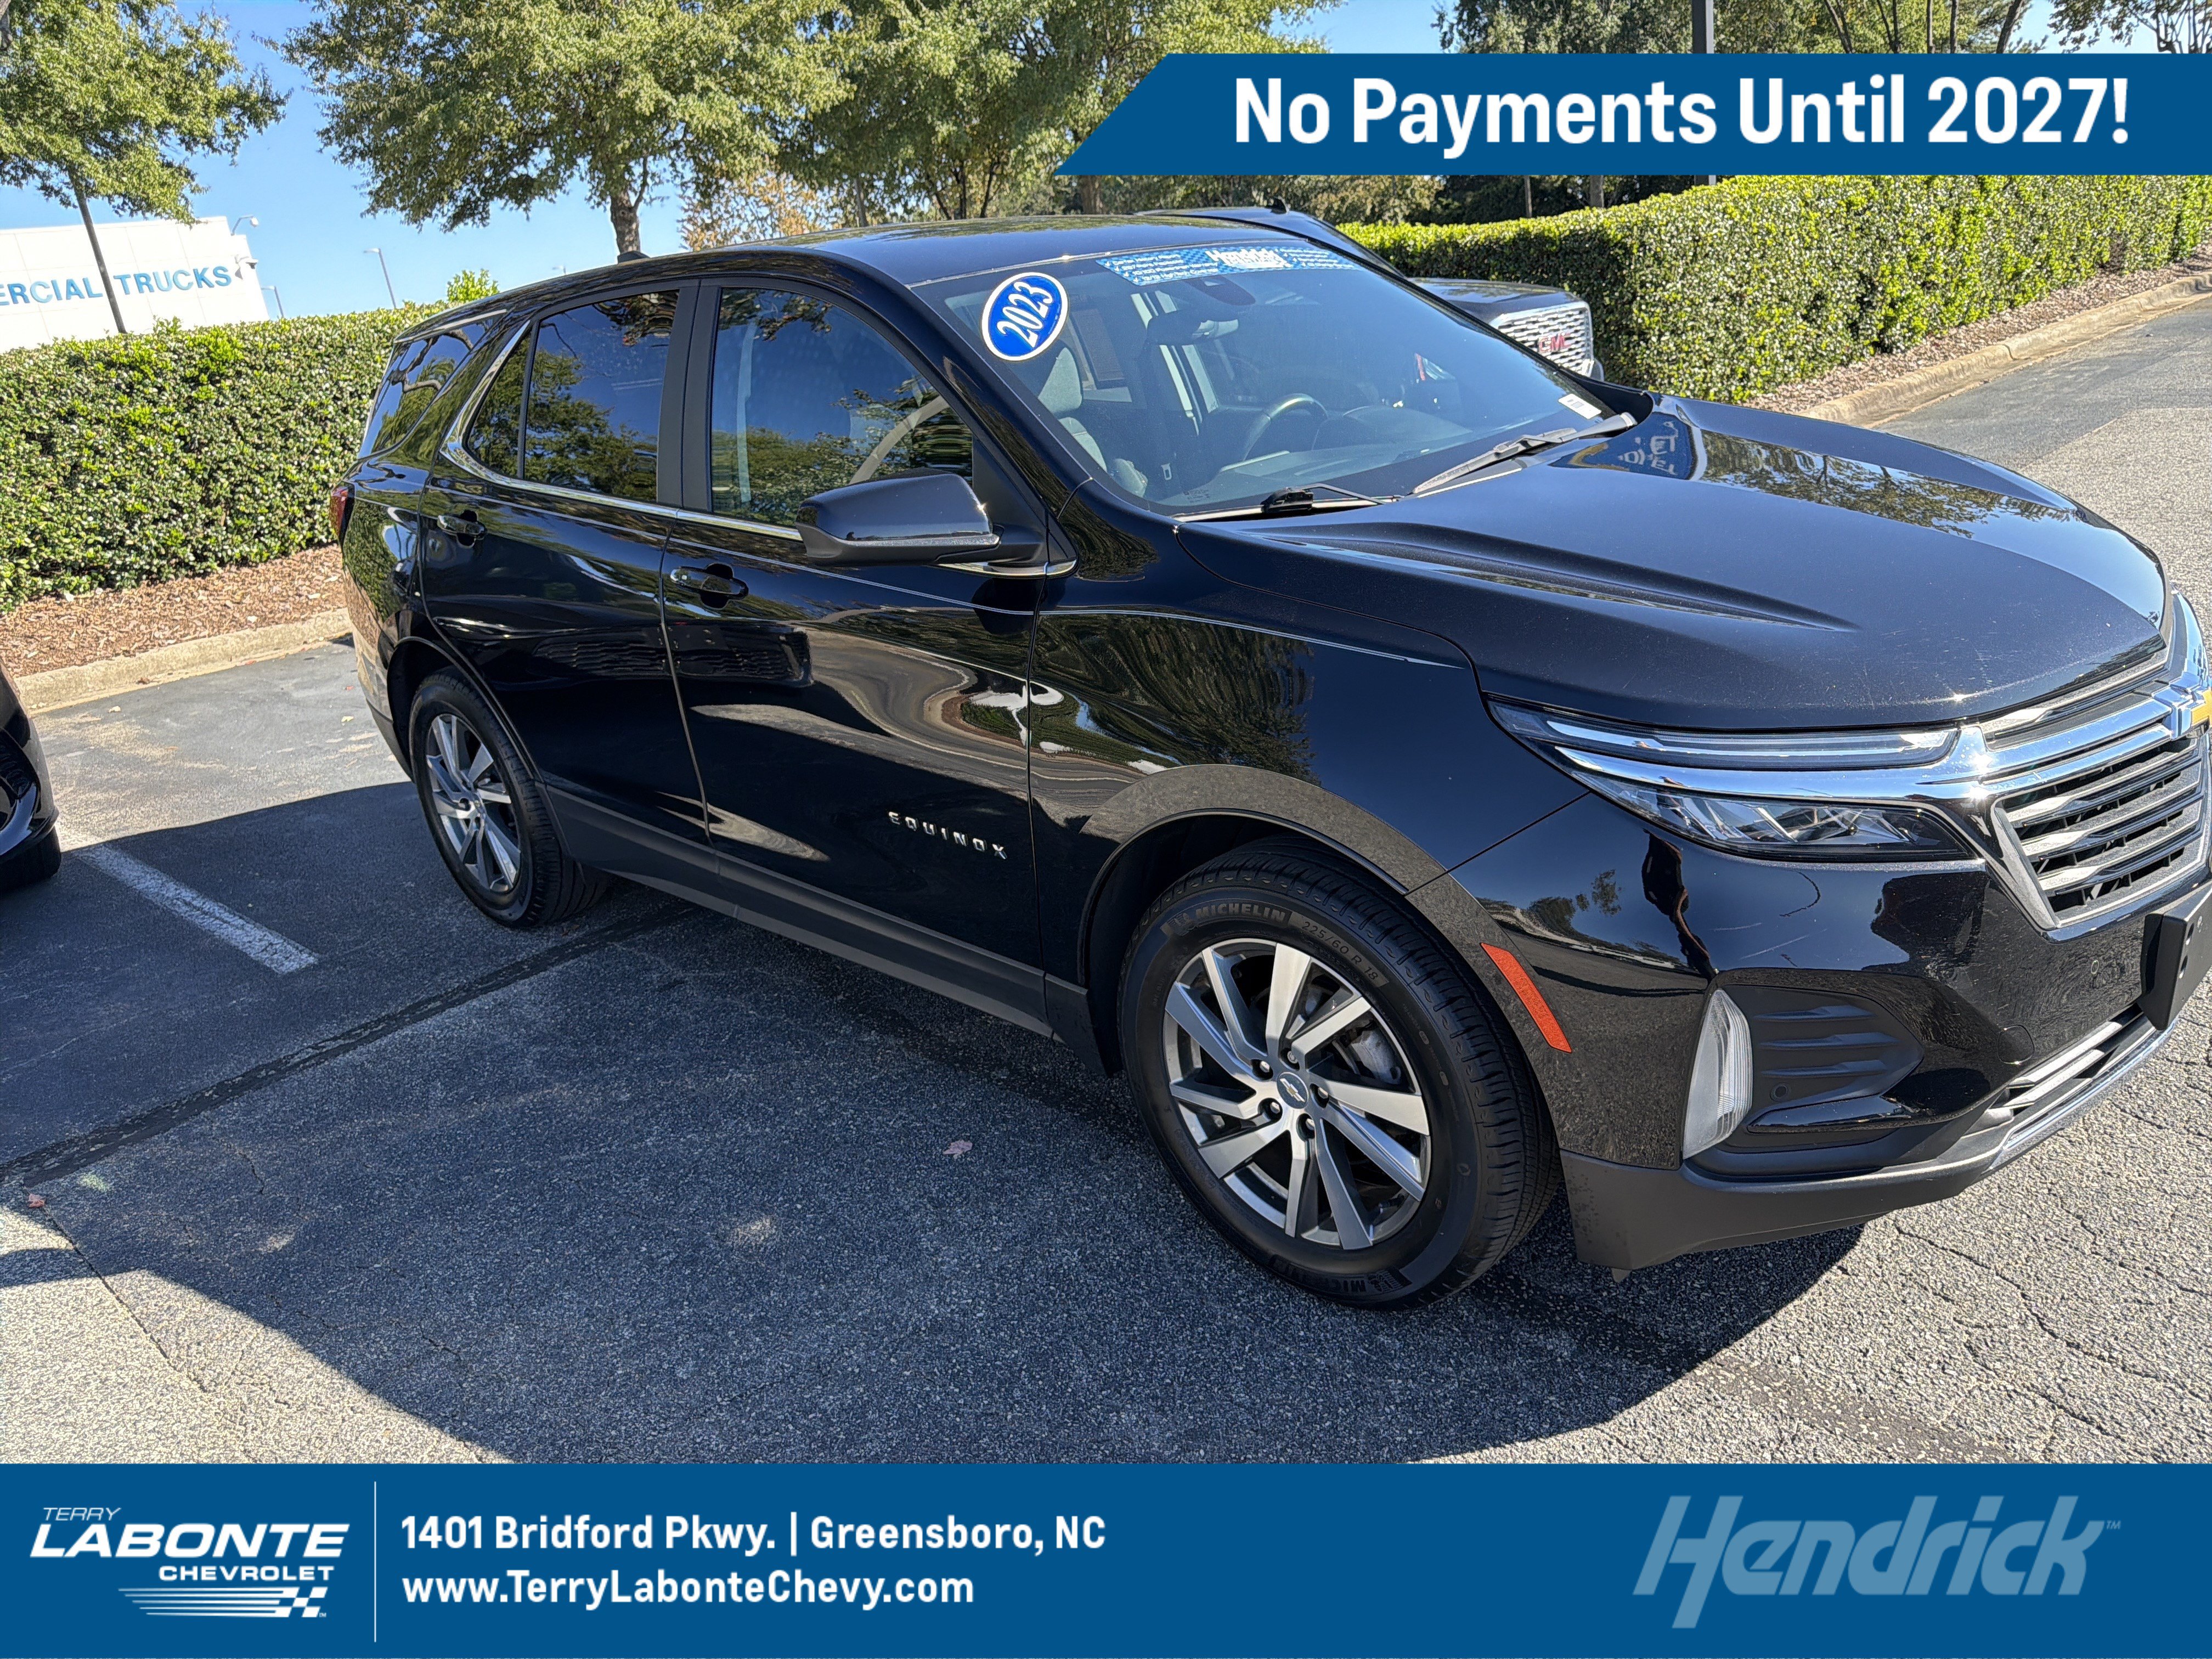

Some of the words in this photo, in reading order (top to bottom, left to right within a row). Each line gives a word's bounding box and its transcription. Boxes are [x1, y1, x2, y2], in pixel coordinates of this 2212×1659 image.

[114, 266, 231, 295] TRUCKS
[997, 281, 1053, 347] 2023
[1538, 331, 1571, 353] GMC
[888, 811, 1007, 860] EQUINOX
[1195, 903, 1285, 922] MICHELIN
[1301, 921, 1349, 955] 225/60
[1351, 955, 1362, 965] R
[1364, 966, 1379, 980] 18
